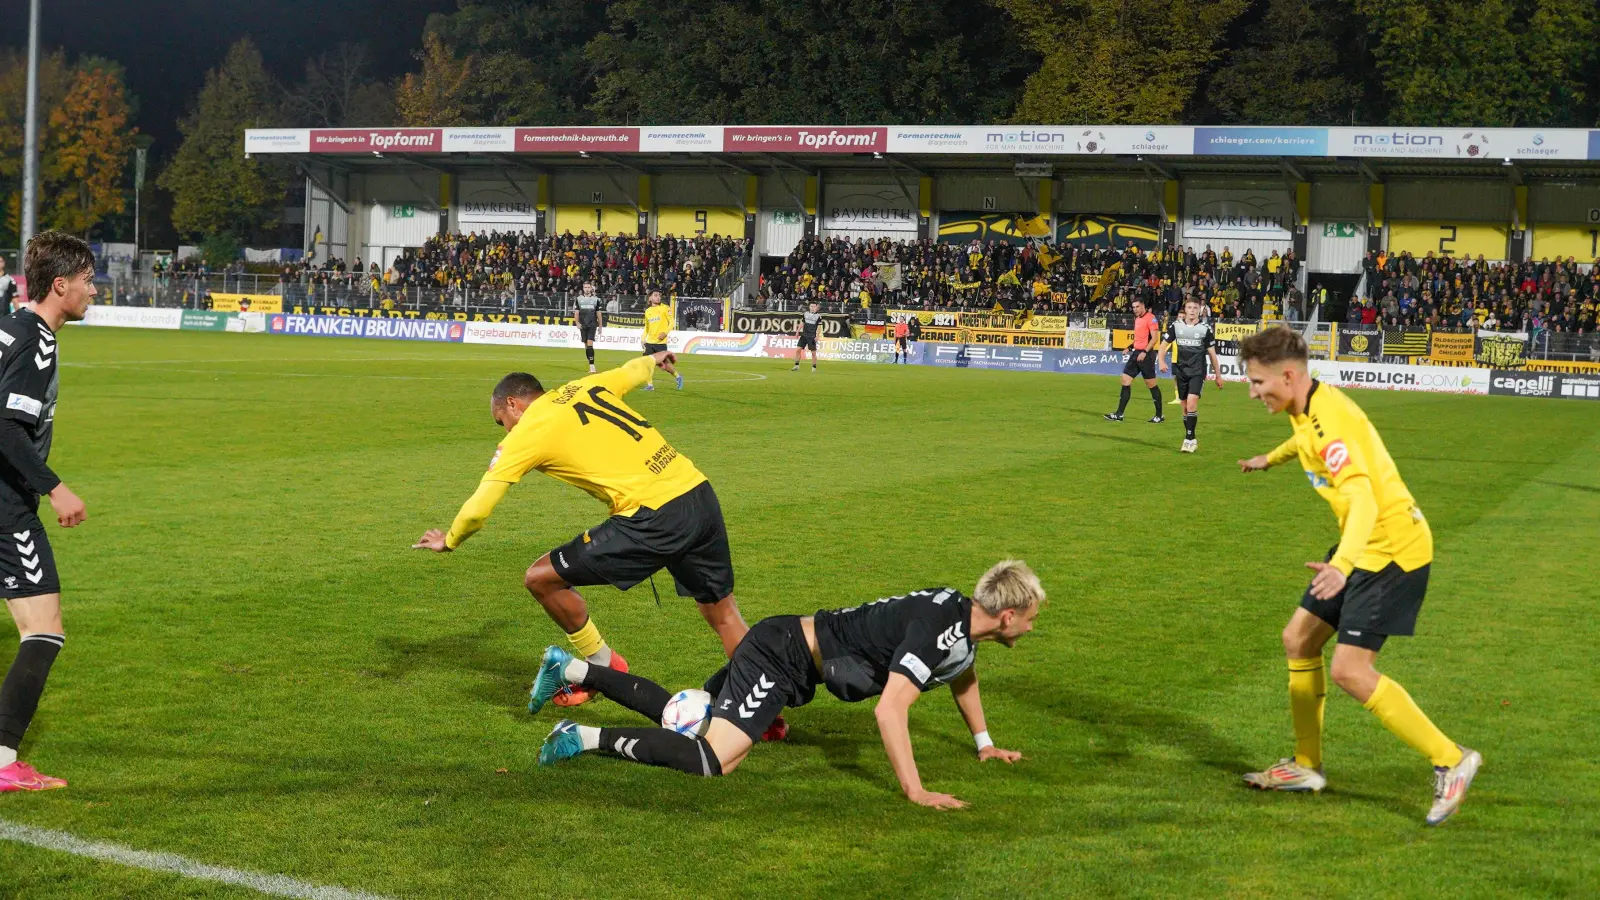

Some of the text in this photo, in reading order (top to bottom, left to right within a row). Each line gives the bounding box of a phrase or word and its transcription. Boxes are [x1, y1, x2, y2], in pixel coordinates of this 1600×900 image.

[328, 136, 357, 144] bringen's
[369, 132, 435, 149] Topform!
[523, 134, 629, 144] formentechnik-bayreuth.de
[747, 134, 783, 143] bringen's
[798, 130, 878, 149] Topform!
[986, 130, 1065, 143] motion
[1210, 135, 1315, 146] schlaeger.com/karriere
[1354, 132, 1443, 146] motion
[1132, 143, 1169, 152] schlaeger
[1516, 147, 1560, 156] schlaeger
[593, 192, 601, 202] M
[985, 197, 994, 209] N
[464, 202, 532, 215] BAYREUTH
[831, 207, 911, 222] BAYREUTH
[695, 210, 708, 234] 9
[1192, 214, 1284, 230] BAYREUTH
[1439, 225, 1457, 254] 2
[114, 312, 138, 322] level
[141, 313, 176, 325] brands
[454, 312, 577, 326] BAYREUT
[934, 313, 955, 326] 1921
[284, 316, 448, 340] FRANKEN BRUNNEN
[467, 328, 543, 341] hagebaumarkt
[700, 338, 741, 348] SW color
[769, 338, 799, 349] FARB
[830, 340, 870, 352] UNSER
[920, 331, 956, 342] GERADE
[976, 333, 1008, 344] SPVGG
[1013, 336, 1064, 346] BAYREUTH
[1058, 354, 1098, 368] IMMER
[1100, 354, 1119, 364] AM
[1340, 370, 1459, 387] WEDLICH.COM
[1493, 375, 1554, 393] capelli
